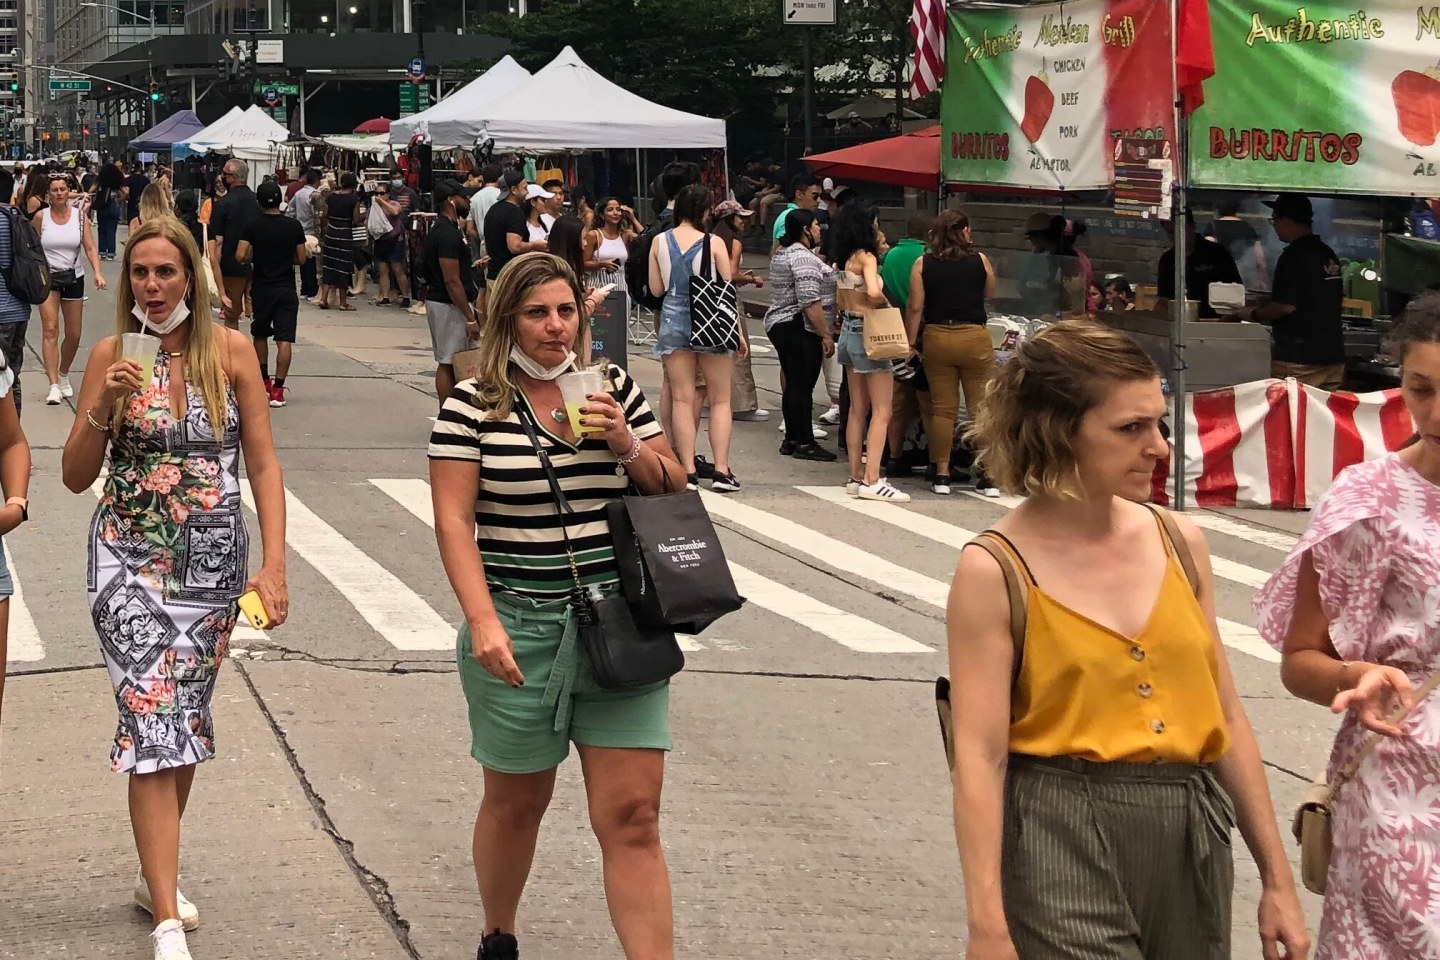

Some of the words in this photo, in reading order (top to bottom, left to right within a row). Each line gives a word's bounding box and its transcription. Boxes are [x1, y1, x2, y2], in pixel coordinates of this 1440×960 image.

[1102, 14, 1135, 48] Grill
[1246, 7, 1384, 48] Authentic
[1054, 57, 1086, 73] CHICKEN
[1061, 92, 1079, 106] BEEF
[1060, 126, 1078, 138] PORK
[951, 132, 1009, 161] BURRITOS
[1210, 126, 1362, 165] BURRITOS
[1413, 163, 1437, 176] AL
[658, 540, 707, 552] Abercrombie
[678, 550, 701, 561] Fitch
